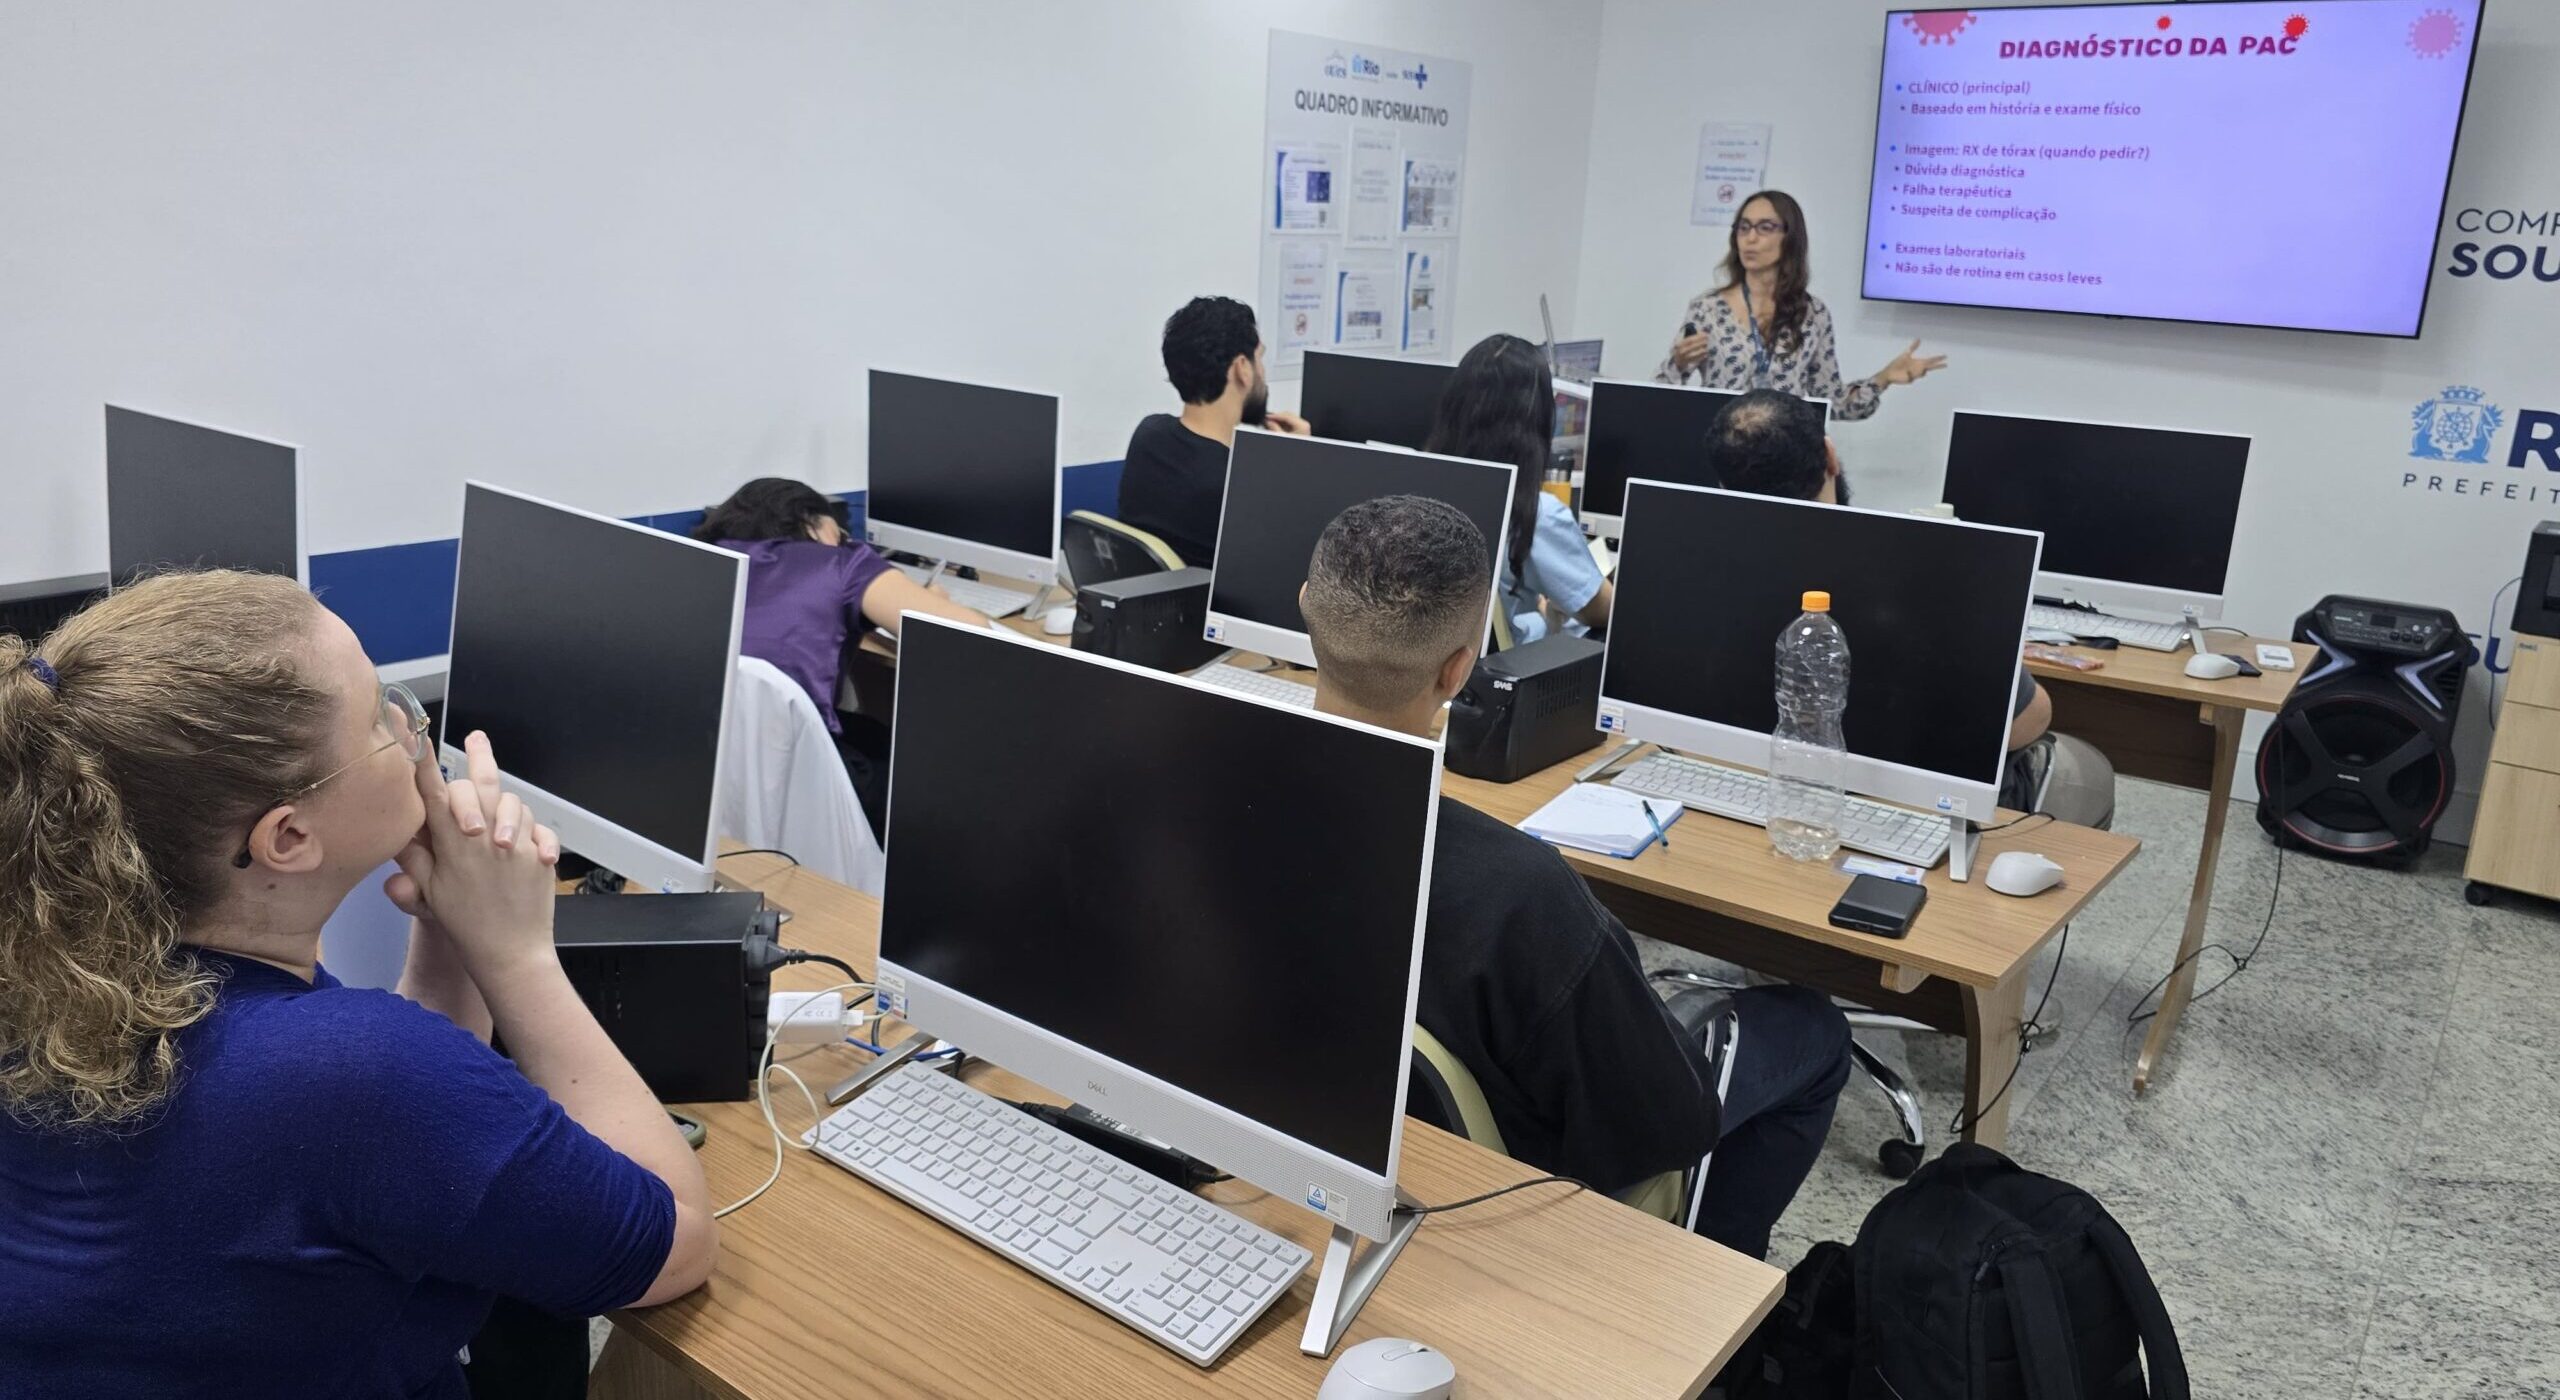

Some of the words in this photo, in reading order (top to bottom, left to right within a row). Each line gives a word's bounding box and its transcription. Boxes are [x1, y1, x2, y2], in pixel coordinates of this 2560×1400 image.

[2000, 33, 2182, 58] DIAGNÓSTICO
[2189, 37, 2227, 55] DA
[2239, 35, 2300, 55] PAC
[1908, 80, 1959, 94] CLÍNICO
[1962, 81, 2030, 96] (principal)
[1295, 89, 1358, 116] QUADRO
[1361, 98, 1448, 127] INFORMATIVO
[1911, 102, 1963, 115] Baseado
[1966, 105, 1986, 115] em
[1990, 102, 2040, 115] história
[2043, 105, 2052, 115] e
[2055, 105, 2100, 115] exame
[2103, 102, 2141, 115] físico
[1904, 144, 1959, 158] Imagem:
[1962, 145, 1979, 155] RX
[1982, 145, 1999, 157] de
[2001, 144, 2036, 158] tórax
[2039, 145, 2096, 160] (quando
[2099, 145, 2150, 162] pedir?)
[1904, 163, 1948, 176] Dúvida
[1950, 164, 2025, 180] diagnóstica
[1902, 183, 1936, 196] Falha
[1938, 185, 2012, 199] terapêutica
[1901, 204, 1954, 217] Suspeita
[1956, 206, 1972, 217] de
[1975, 207, 2057, 222] complicação
[1895, 243, 1941, 256] Exames
[1943, 244, 2026, 260] laboratoriais
[2447, 242, 2560, 282] SOU
[1895, 262, 1919, 274] Não
[1921, 264, 1942, 275] são
[1945, 265, 1961, 277] de
[1963, 265, 2002, 279] rotina
[2004, 269, 2025, 280] em
[2028, 271, 2064, 283] casos
[2067, 271, 2103, 285] leves
[2402, 472, 2560, 504] PREFEIT
